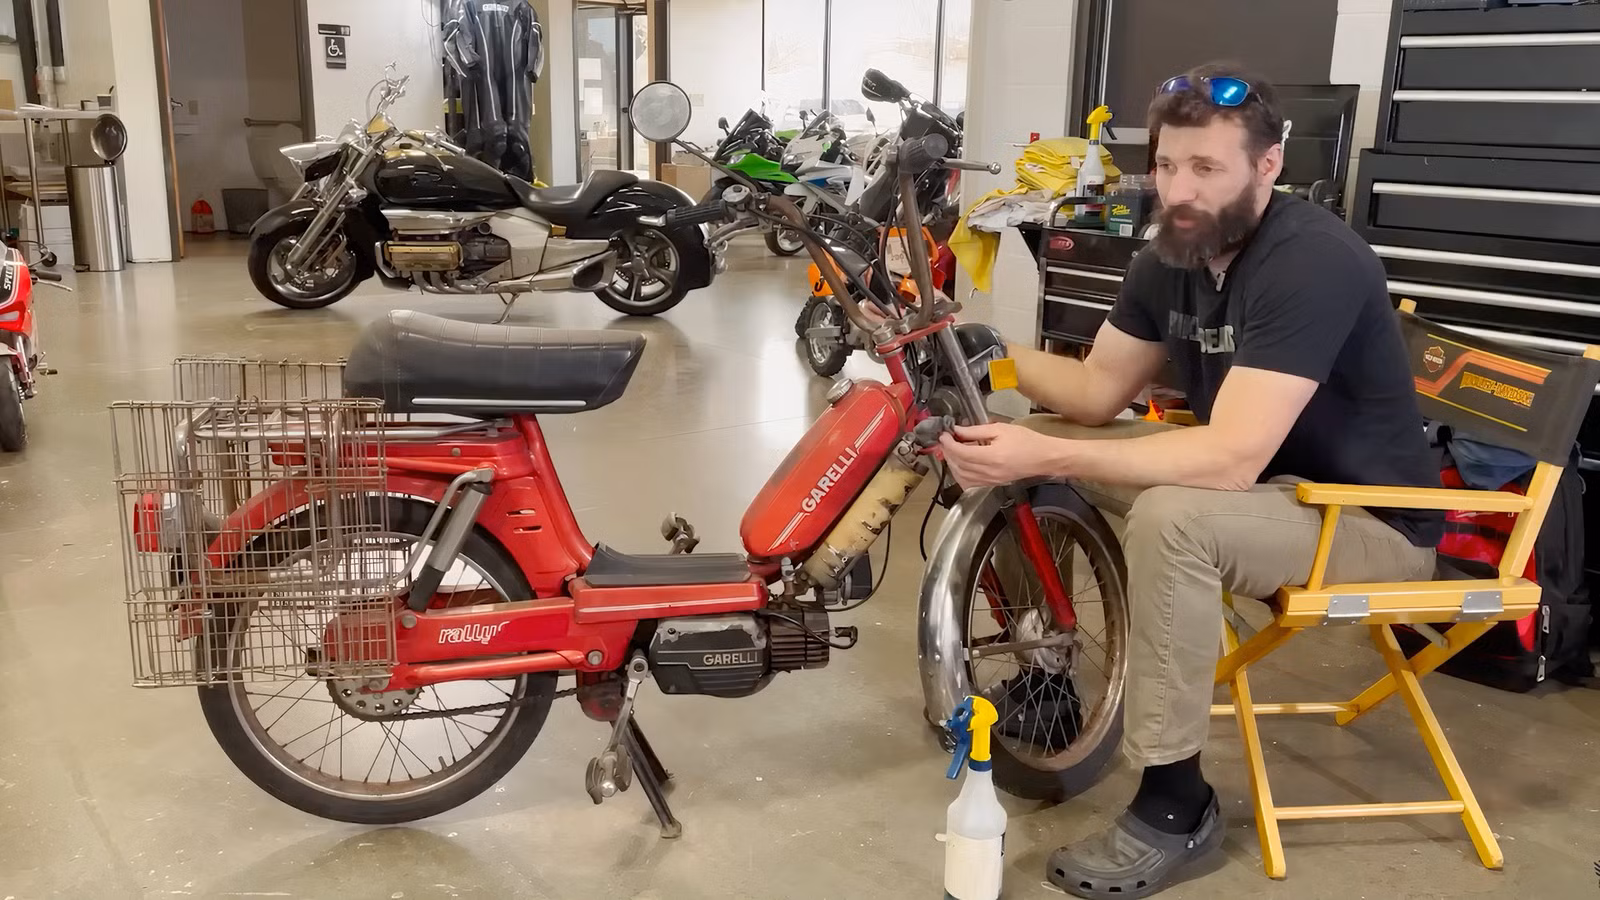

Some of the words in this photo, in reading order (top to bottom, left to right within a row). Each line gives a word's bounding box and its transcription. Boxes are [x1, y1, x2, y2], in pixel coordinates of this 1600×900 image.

[801, 446, 858, 513] GARELLI
[438, 623, 498, 645] rally
[703, 651, 758, 666] GARELLI
